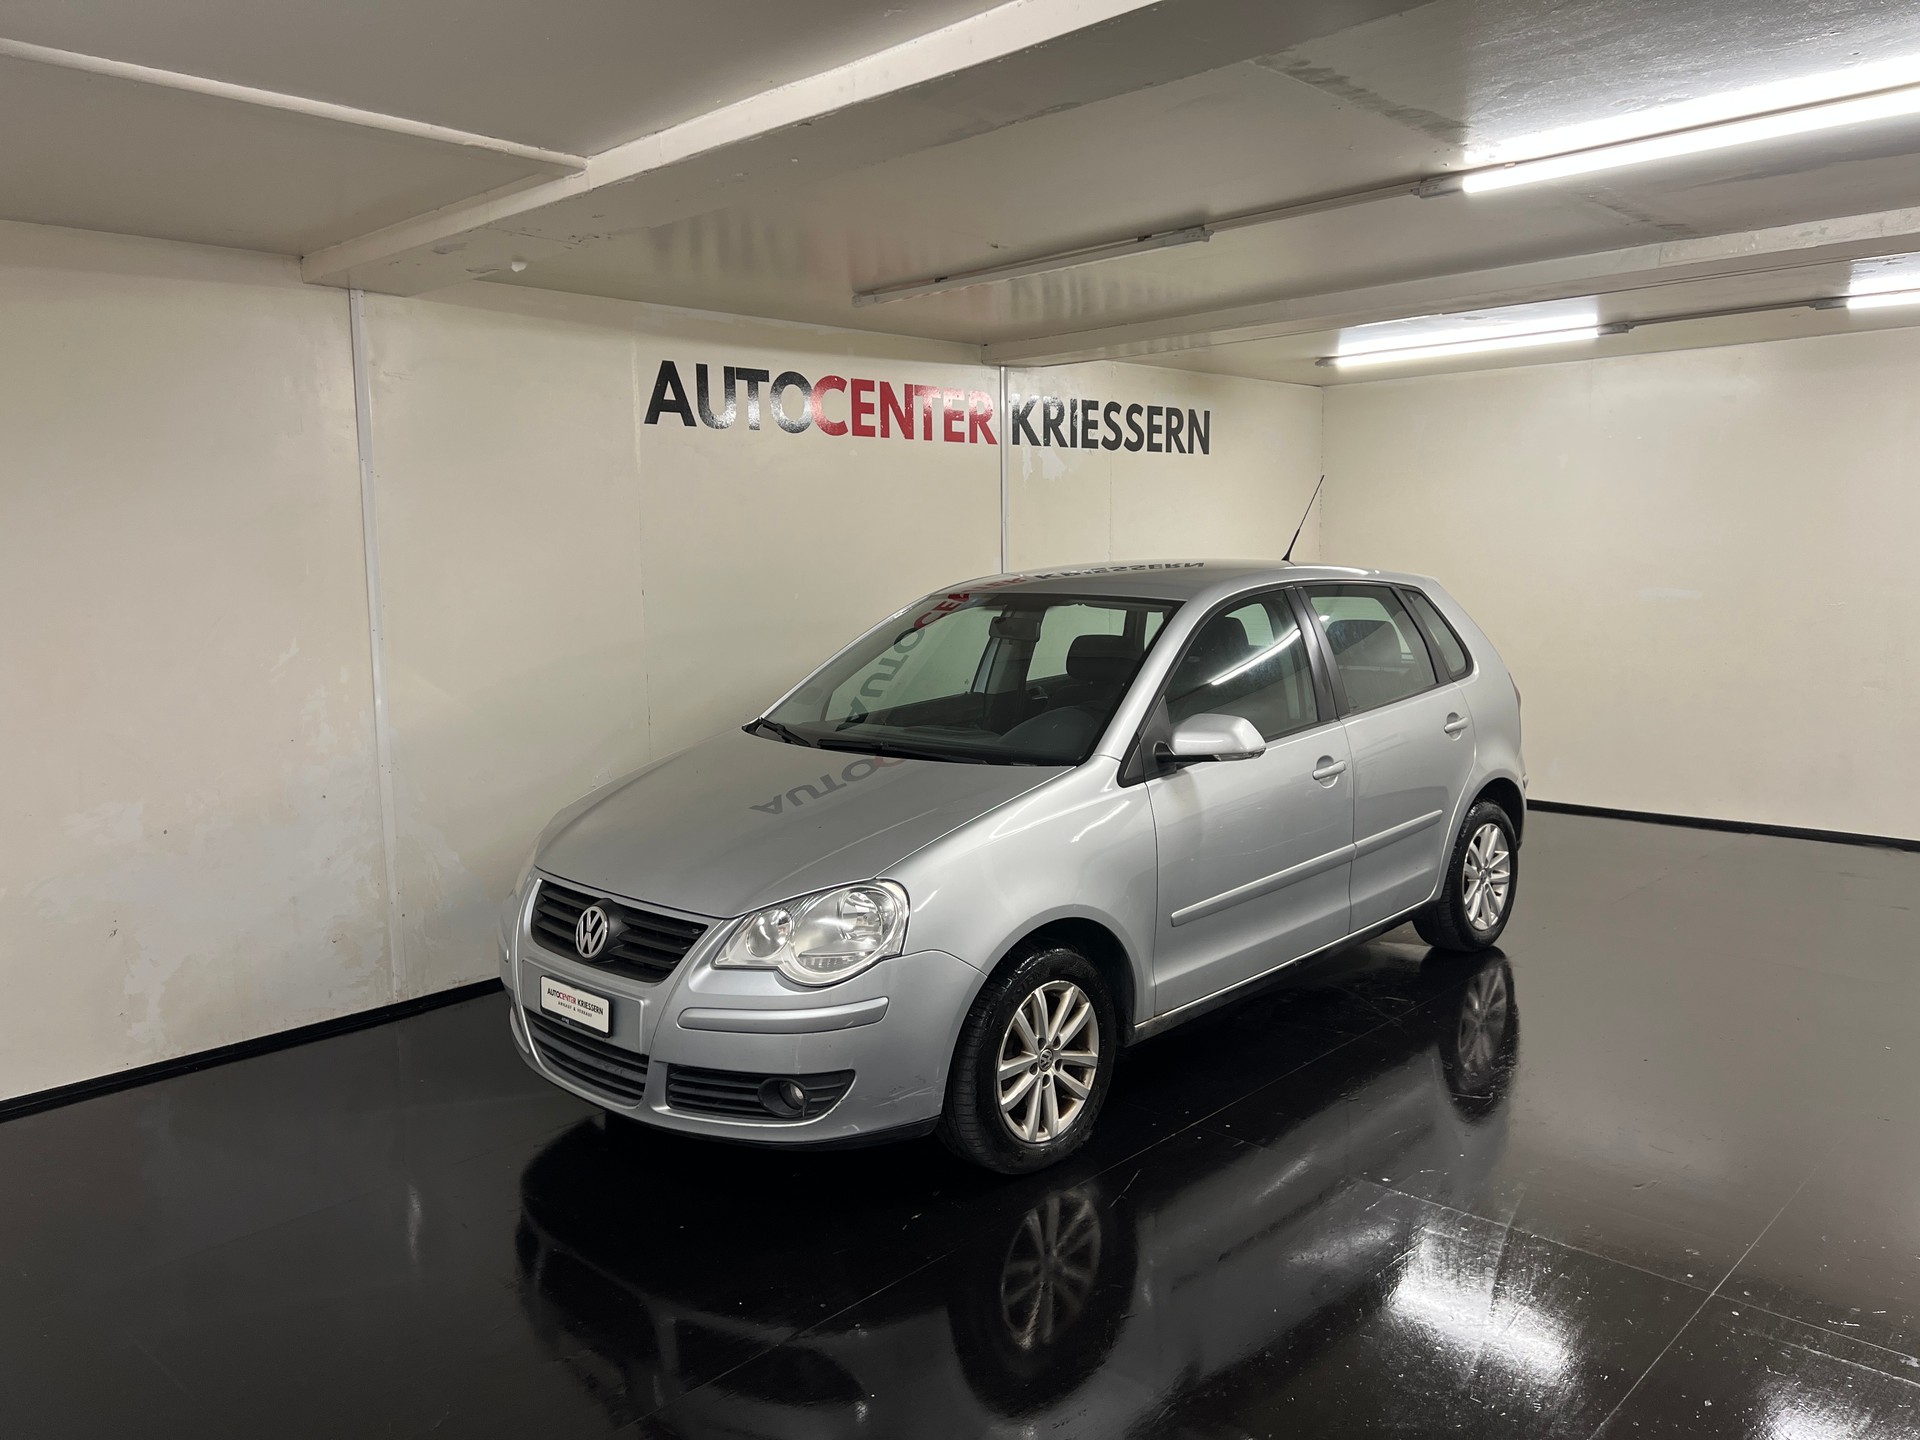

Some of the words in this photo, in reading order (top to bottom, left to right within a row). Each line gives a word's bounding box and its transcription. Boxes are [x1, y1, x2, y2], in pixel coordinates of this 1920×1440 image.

[644, 359, 998, 445] AUTOCENTER
[1011, 392, 1211, 456] KRIESSERN
[577, 999, 603, 1015] KRIESSERN
